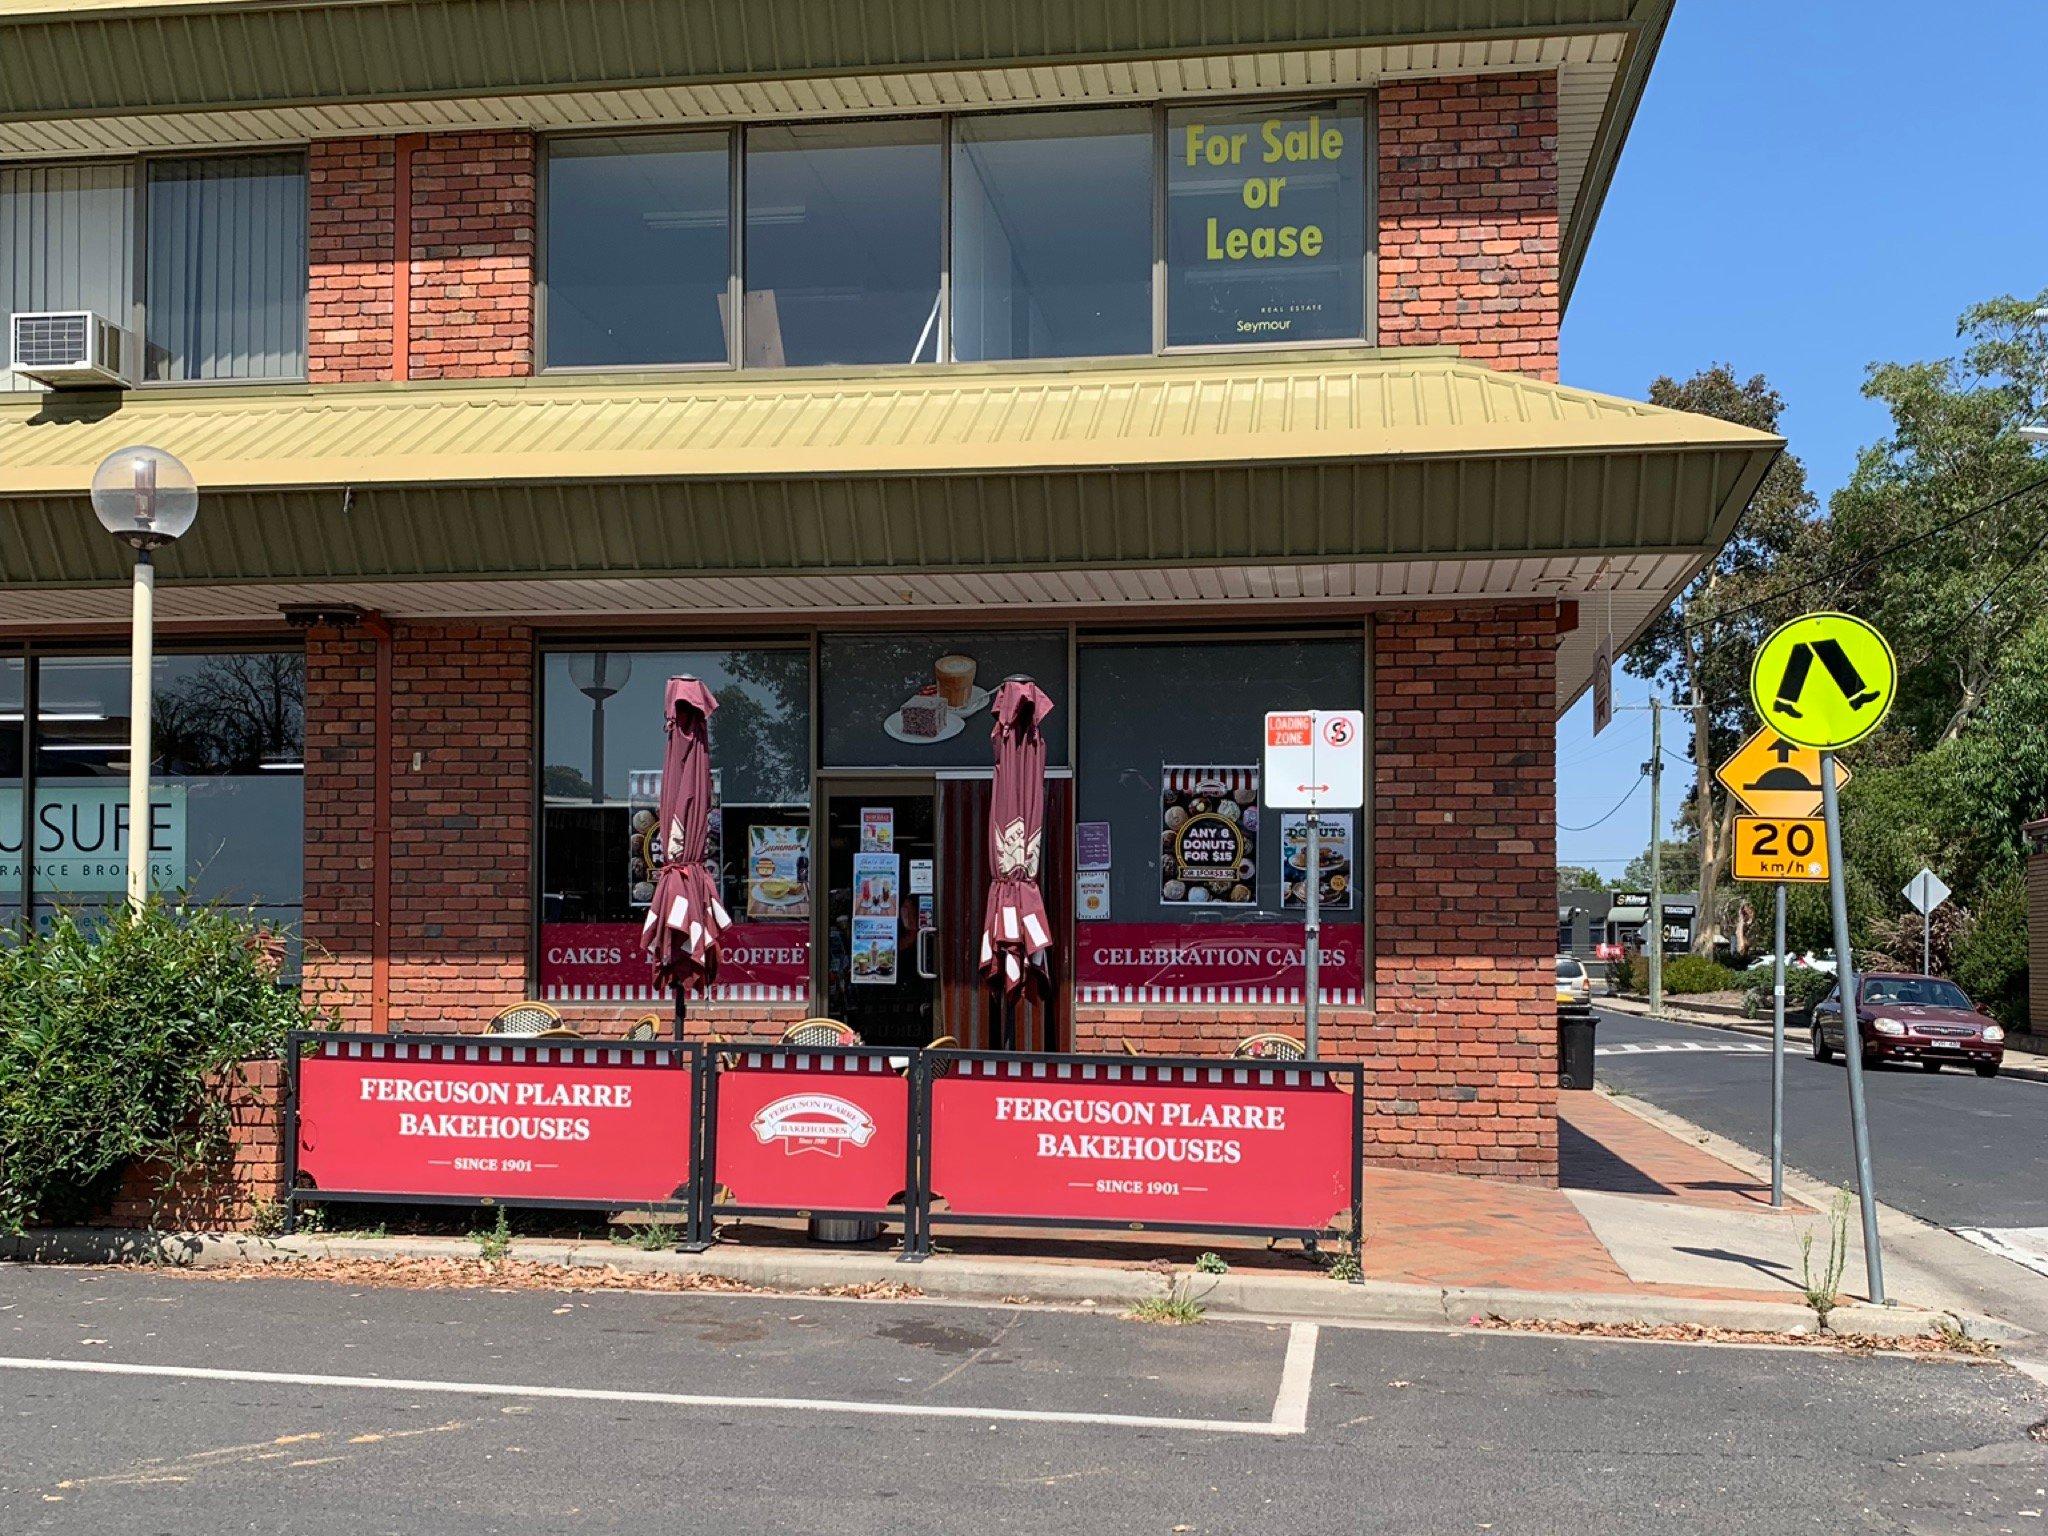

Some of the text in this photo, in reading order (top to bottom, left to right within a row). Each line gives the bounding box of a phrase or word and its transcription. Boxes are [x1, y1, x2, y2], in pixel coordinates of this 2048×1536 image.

[1186, 115, 1344, 167] For Sale
[1242, 176, 1286, 210] or
[1206, 217, 1324, 261] Lease
[1260, 304, 1323, 314] REAL ESTATE
[1236, 319, 1291, 333] Seymour
[1268, 717, 1310, 730] LOADING
[1275, 731, 1305, 744] ZONE
[1189, 828, 1230, 838] ANY 6
[1287, 828, 1346, 838] DOUTS
[1751, 822, 1815, 857] 20
[755, 841, 802, 855] Summer
[1183, 839, 1235, 850] DONUTS
[1184, 850, 1233, 863] FOR $15
[83, 864, 174, 876] BRORS
[1759, 860, 1805, 876] km/h
[1625, 894, 1648, 906] King
[1670, 925, 1689, 943] King
[547, 947, 806, 965] CAKES COFFEE
[1092, 948, 1261, 966] CELEBRATION
[360, 1078, 632, 1108] FERGUSON PLARRE
[768, 1100, 858, 1121] FERGUSON PLARRE
[996, 1097, 1286, 1131] FERGUSON PLARRE
[399, 1113, 590, 1141] BAKEHOUSES
[780, 1125, 848, 1135] BAKEHOUSES
[1036, 1133, 1241, 1164] BAKEHOUSES
[454, 1157, 532, 1172] SINCE 1901
[1096, 1180, 1180, 1196] SINCE 1901
